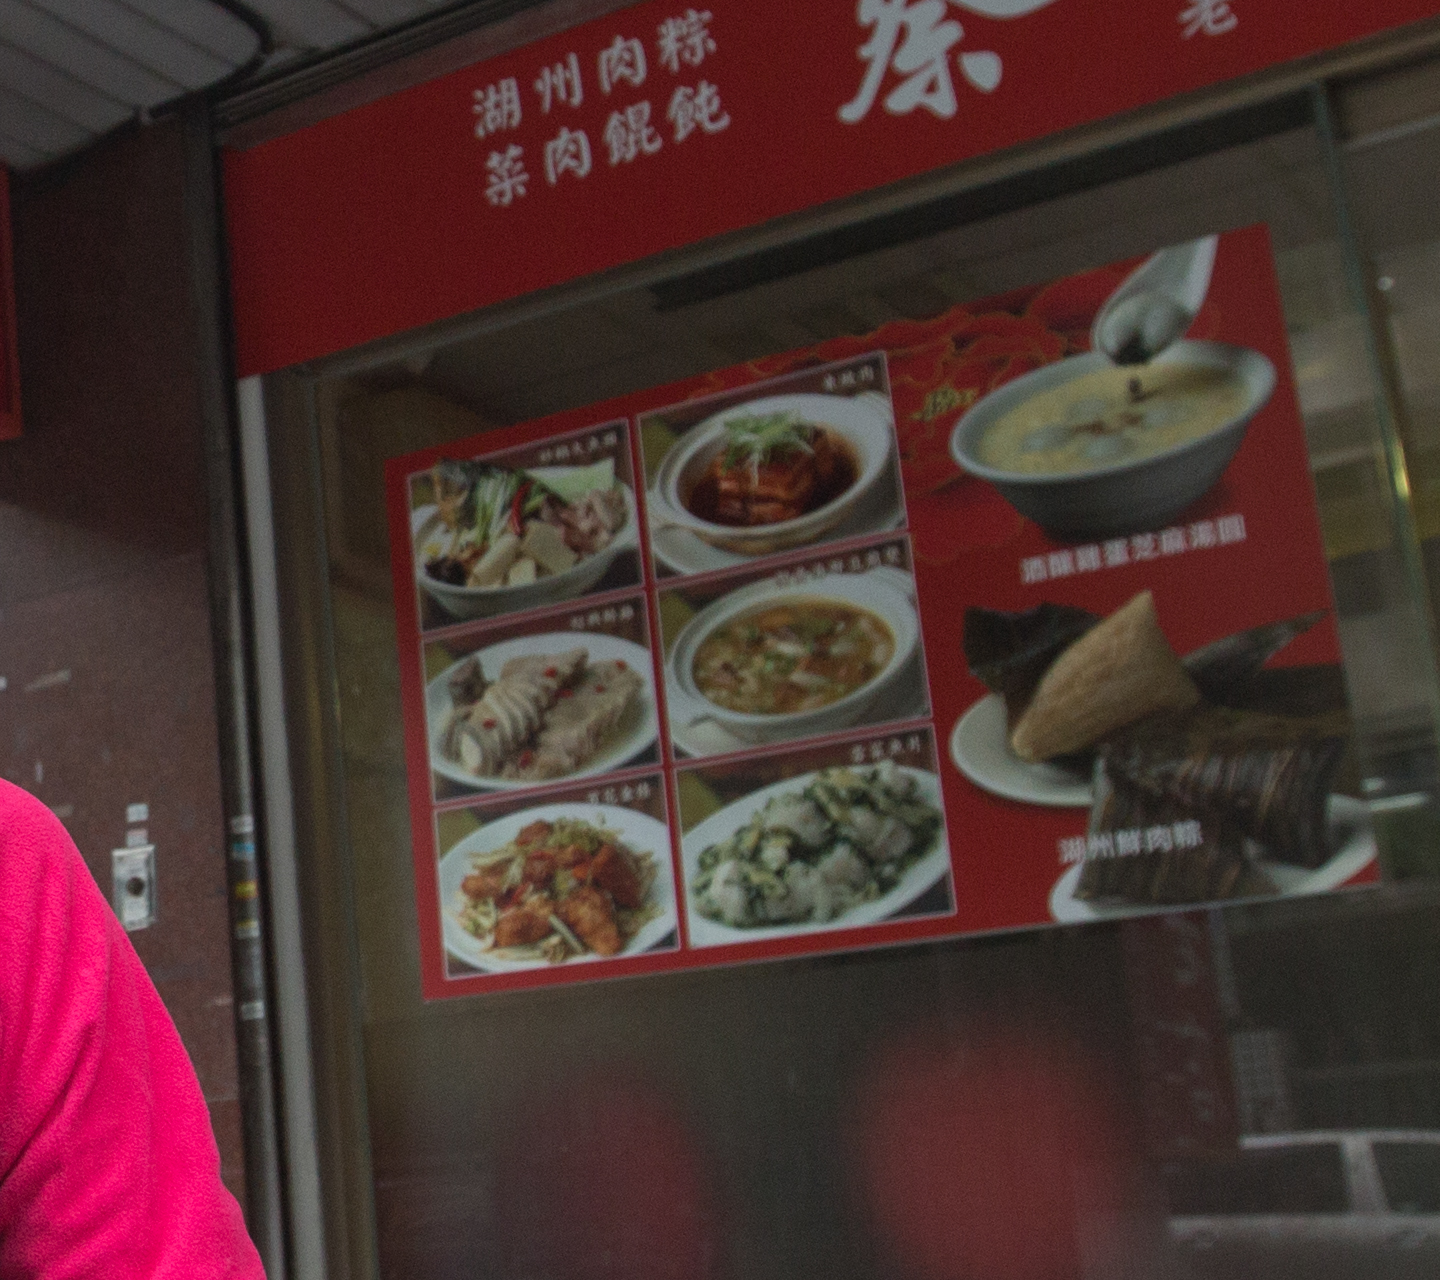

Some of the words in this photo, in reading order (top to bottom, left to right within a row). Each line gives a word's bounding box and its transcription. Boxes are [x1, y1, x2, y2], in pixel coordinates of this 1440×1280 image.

[471, 7, 718, 140] 湖州肉粽
[484, 80, 731, 207] 菜肉餛飩
